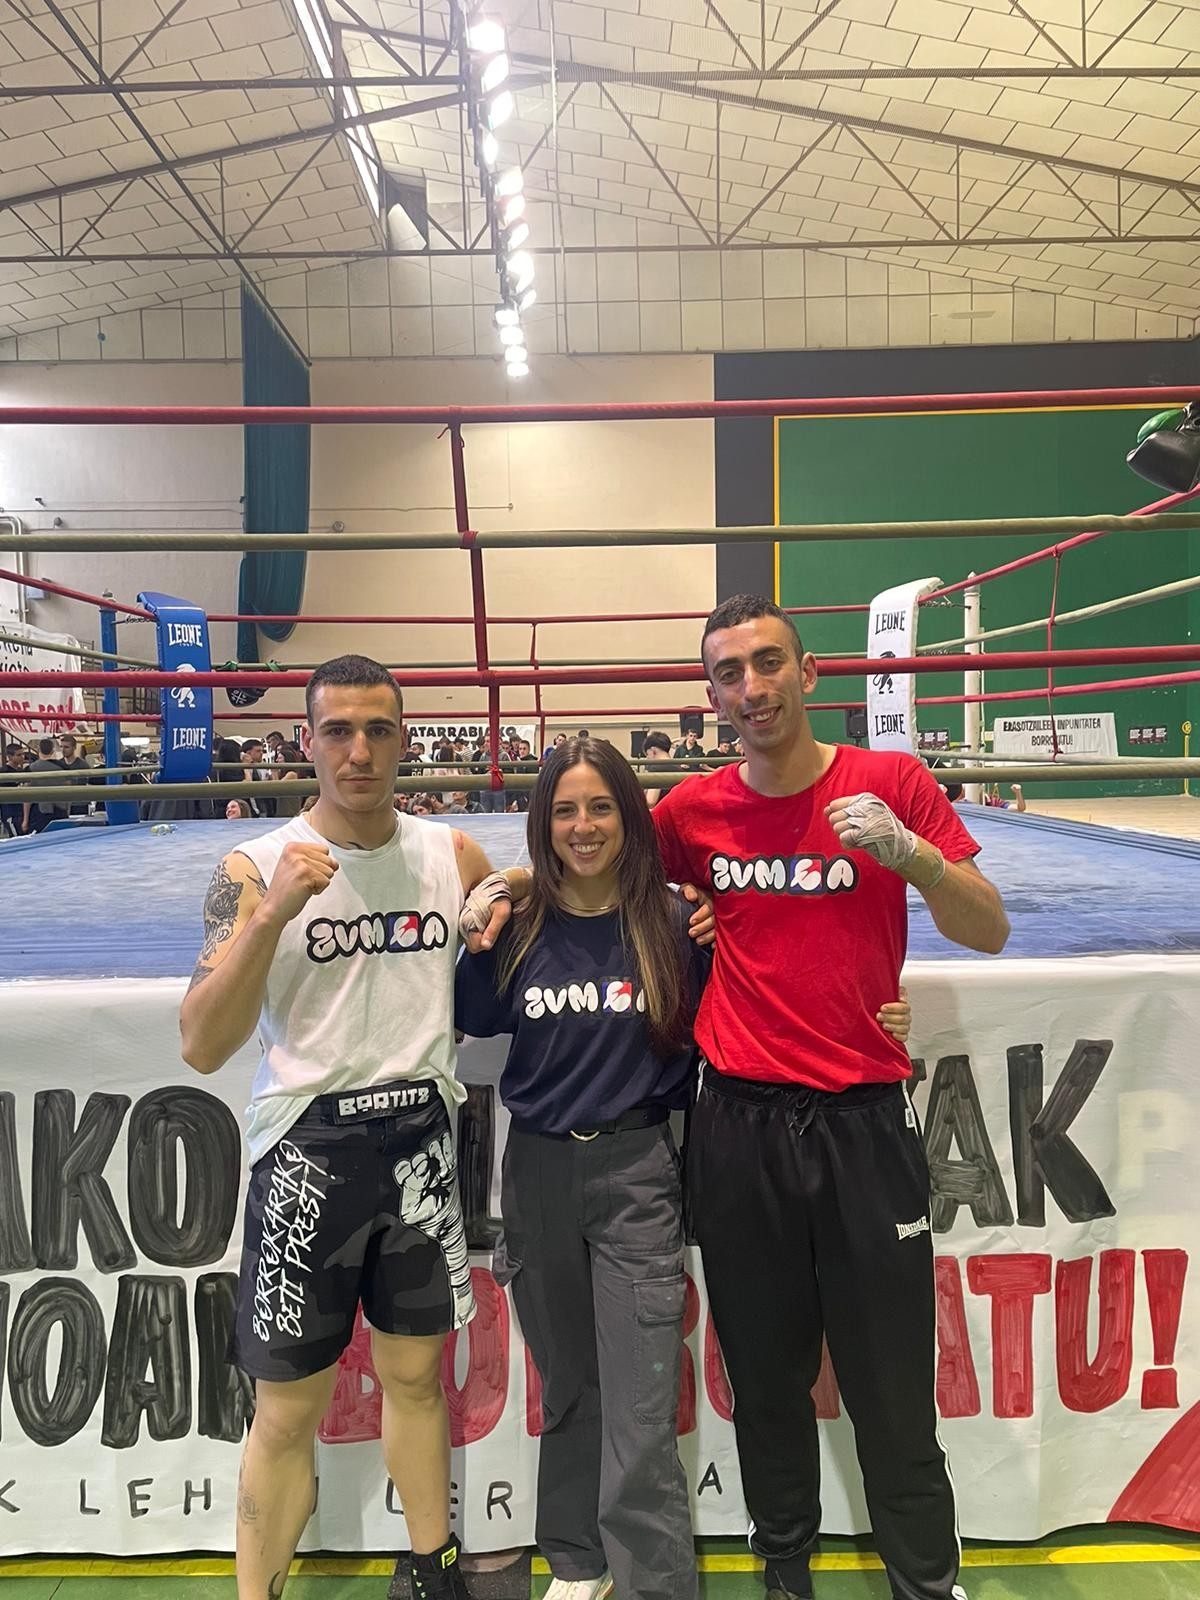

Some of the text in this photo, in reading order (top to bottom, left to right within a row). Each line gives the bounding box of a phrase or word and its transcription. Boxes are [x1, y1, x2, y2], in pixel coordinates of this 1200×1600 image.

[875, 610, 906, 634] LEONE
[167, 623, 203, 647] LEONE
[875, 714, 906, 736] LEONE
[172, 727, 207, 750] LEONE
